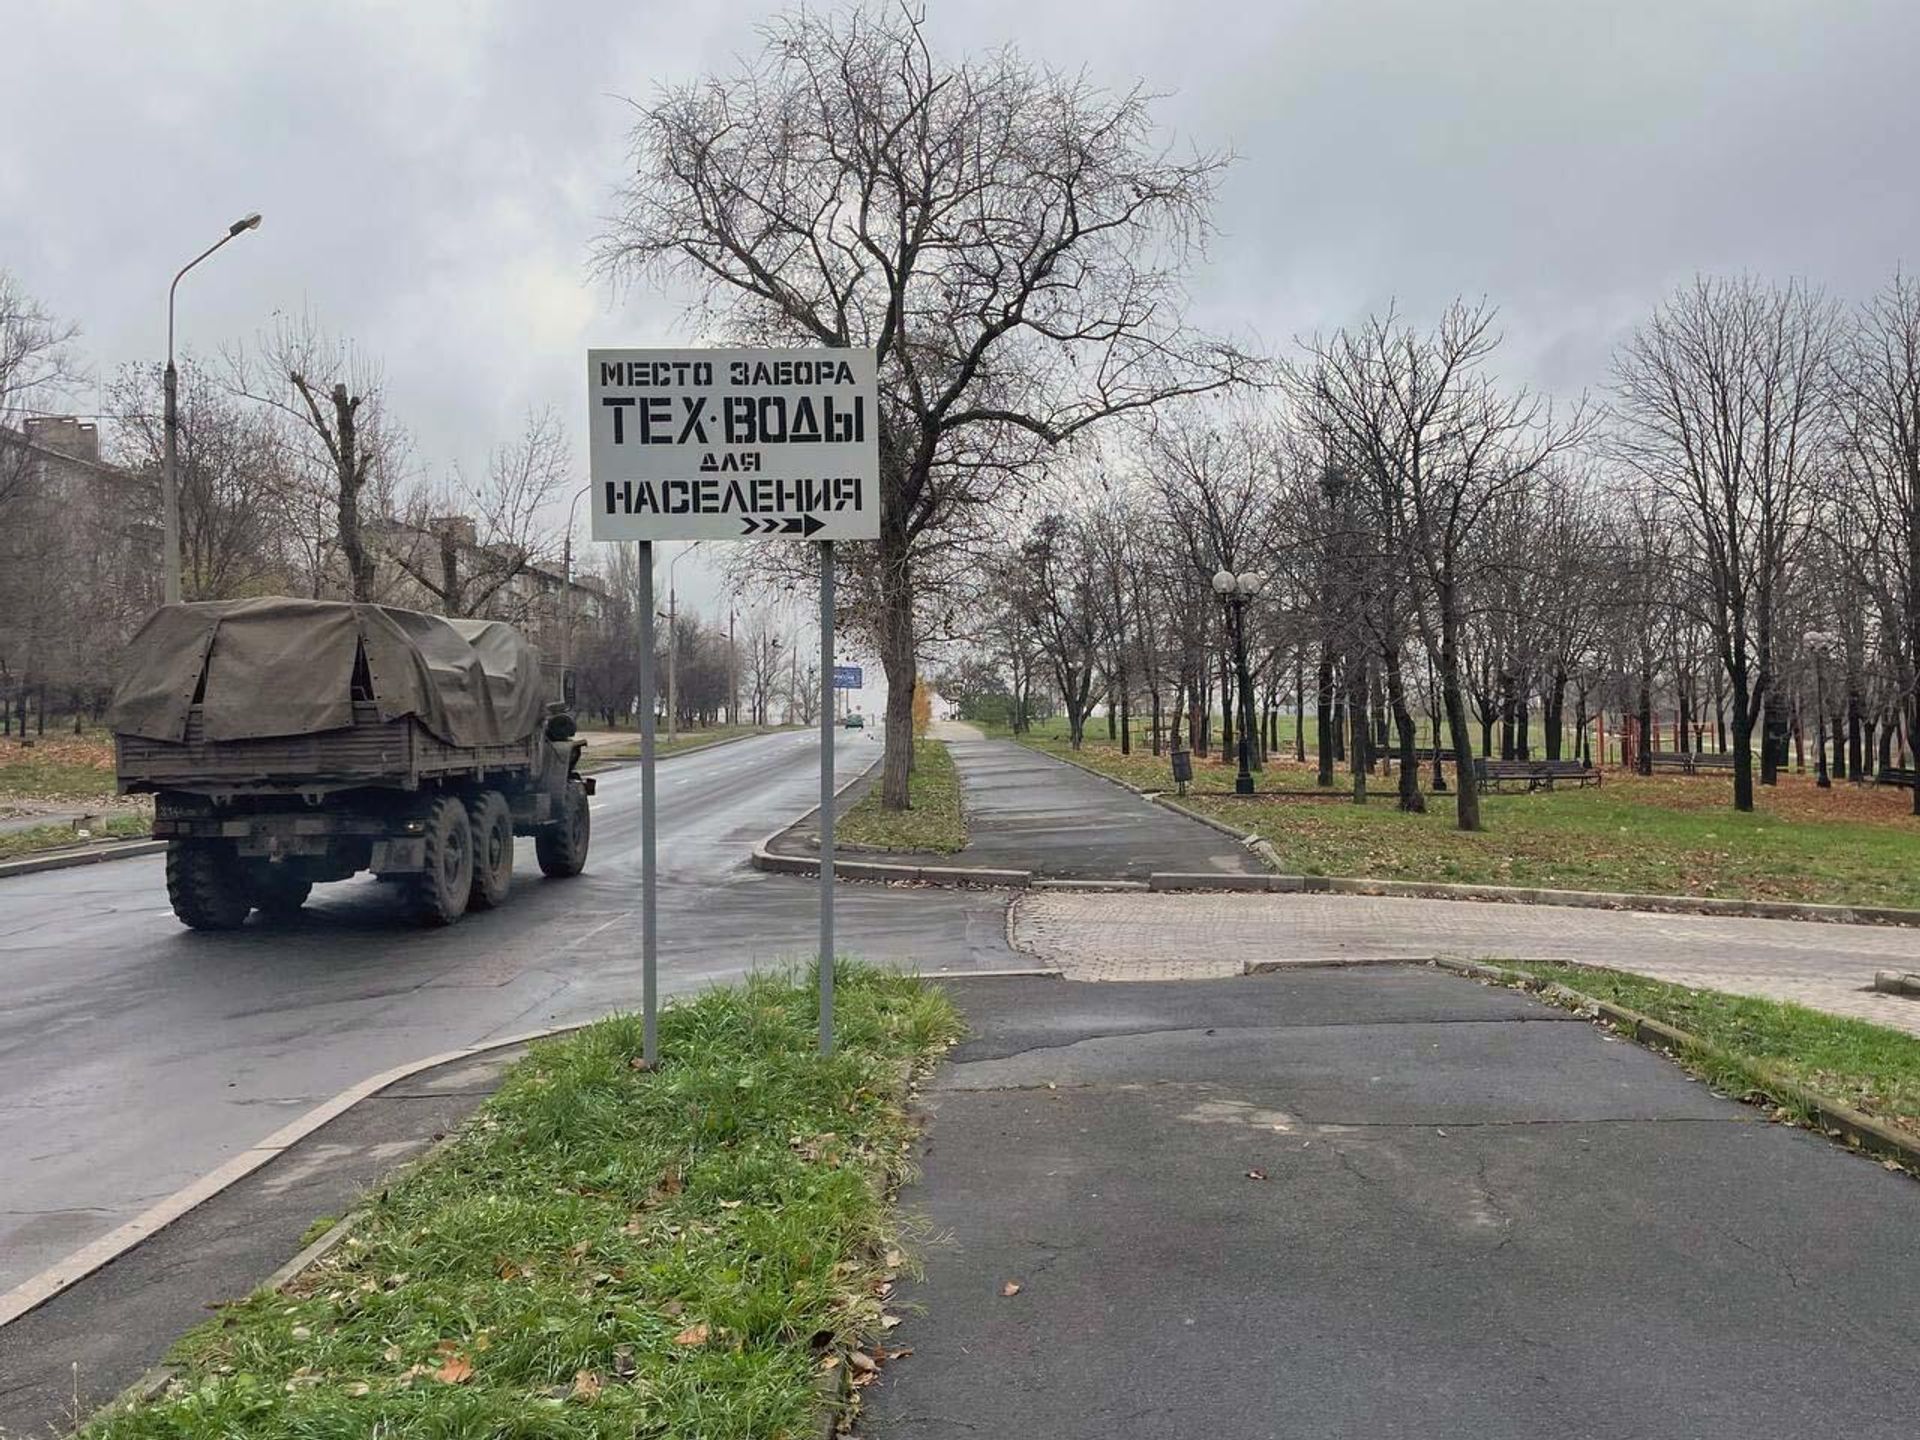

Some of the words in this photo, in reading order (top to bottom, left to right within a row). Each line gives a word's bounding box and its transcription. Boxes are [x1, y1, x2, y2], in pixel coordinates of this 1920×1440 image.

[600, 362, 713, 386] МЕСТО
[730, 361, 856, 385] ЗАБОРА
[700, 452, 761, 472] ДЛЯ
[605, 478, 863, 515] НАСЕЛЕНИЯ
